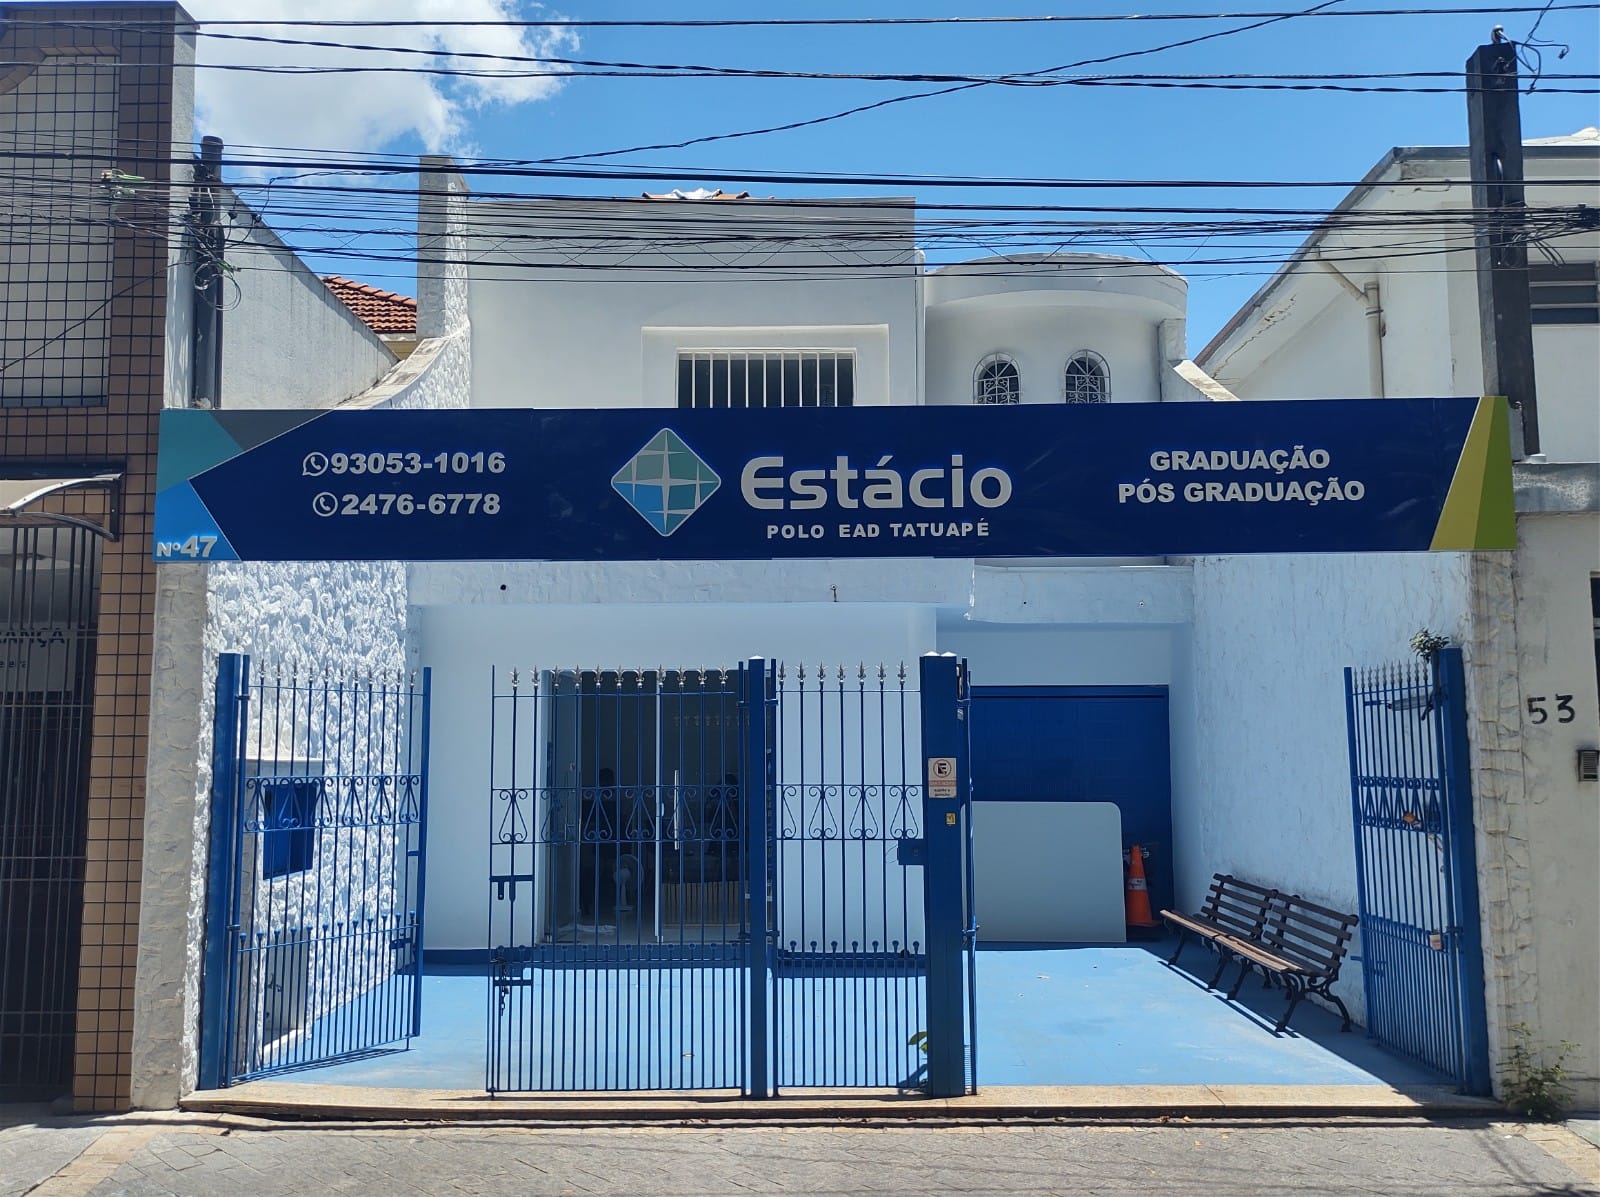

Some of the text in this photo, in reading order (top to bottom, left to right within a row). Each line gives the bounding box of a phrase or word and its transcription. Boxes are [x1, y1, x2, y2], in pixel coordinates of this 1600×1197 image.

[331, 452, 506, 474] 93053-1016
[1150, 445, 1330, 474] GRADUAÇÃO
[741, 454, 1012, 509] Estácio
[1118, 477, 1365, 505] PÓS GRADUAÇÃO
[341, 493, 501, 515] 2476-6778
[767, 517, 989, 539] POLO EAD TATUAPÉ
[1527, 693, 1576, 725] 53
